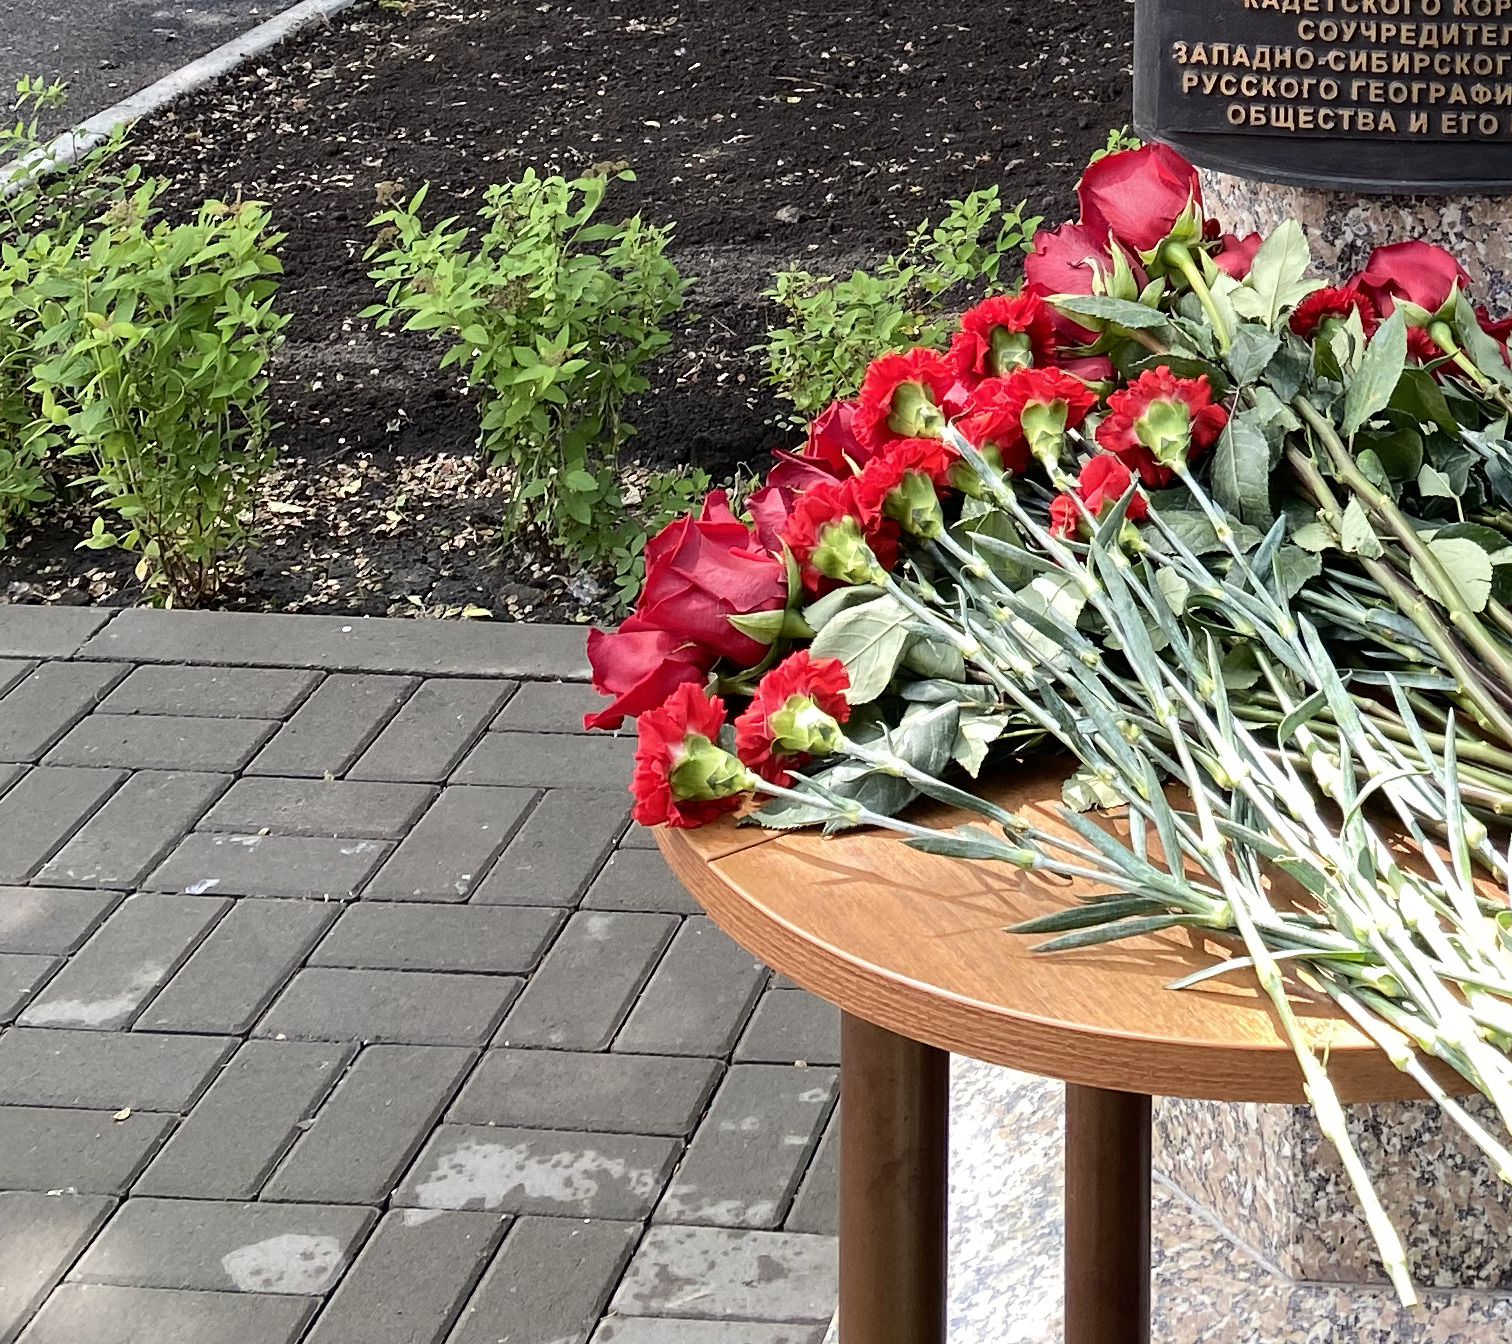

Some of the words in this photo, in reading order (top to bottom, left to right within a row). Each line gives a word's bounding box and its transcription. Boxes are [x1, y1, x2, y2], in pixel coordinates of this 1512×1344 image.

[1182, 74, 1338, 100] РУССКОГО
[1228, 104, 1396, 133] ОБЩЕСТВА
[1410, 111, 1428, 134] И
[1442, 112, 1498, 136] ЕГО
